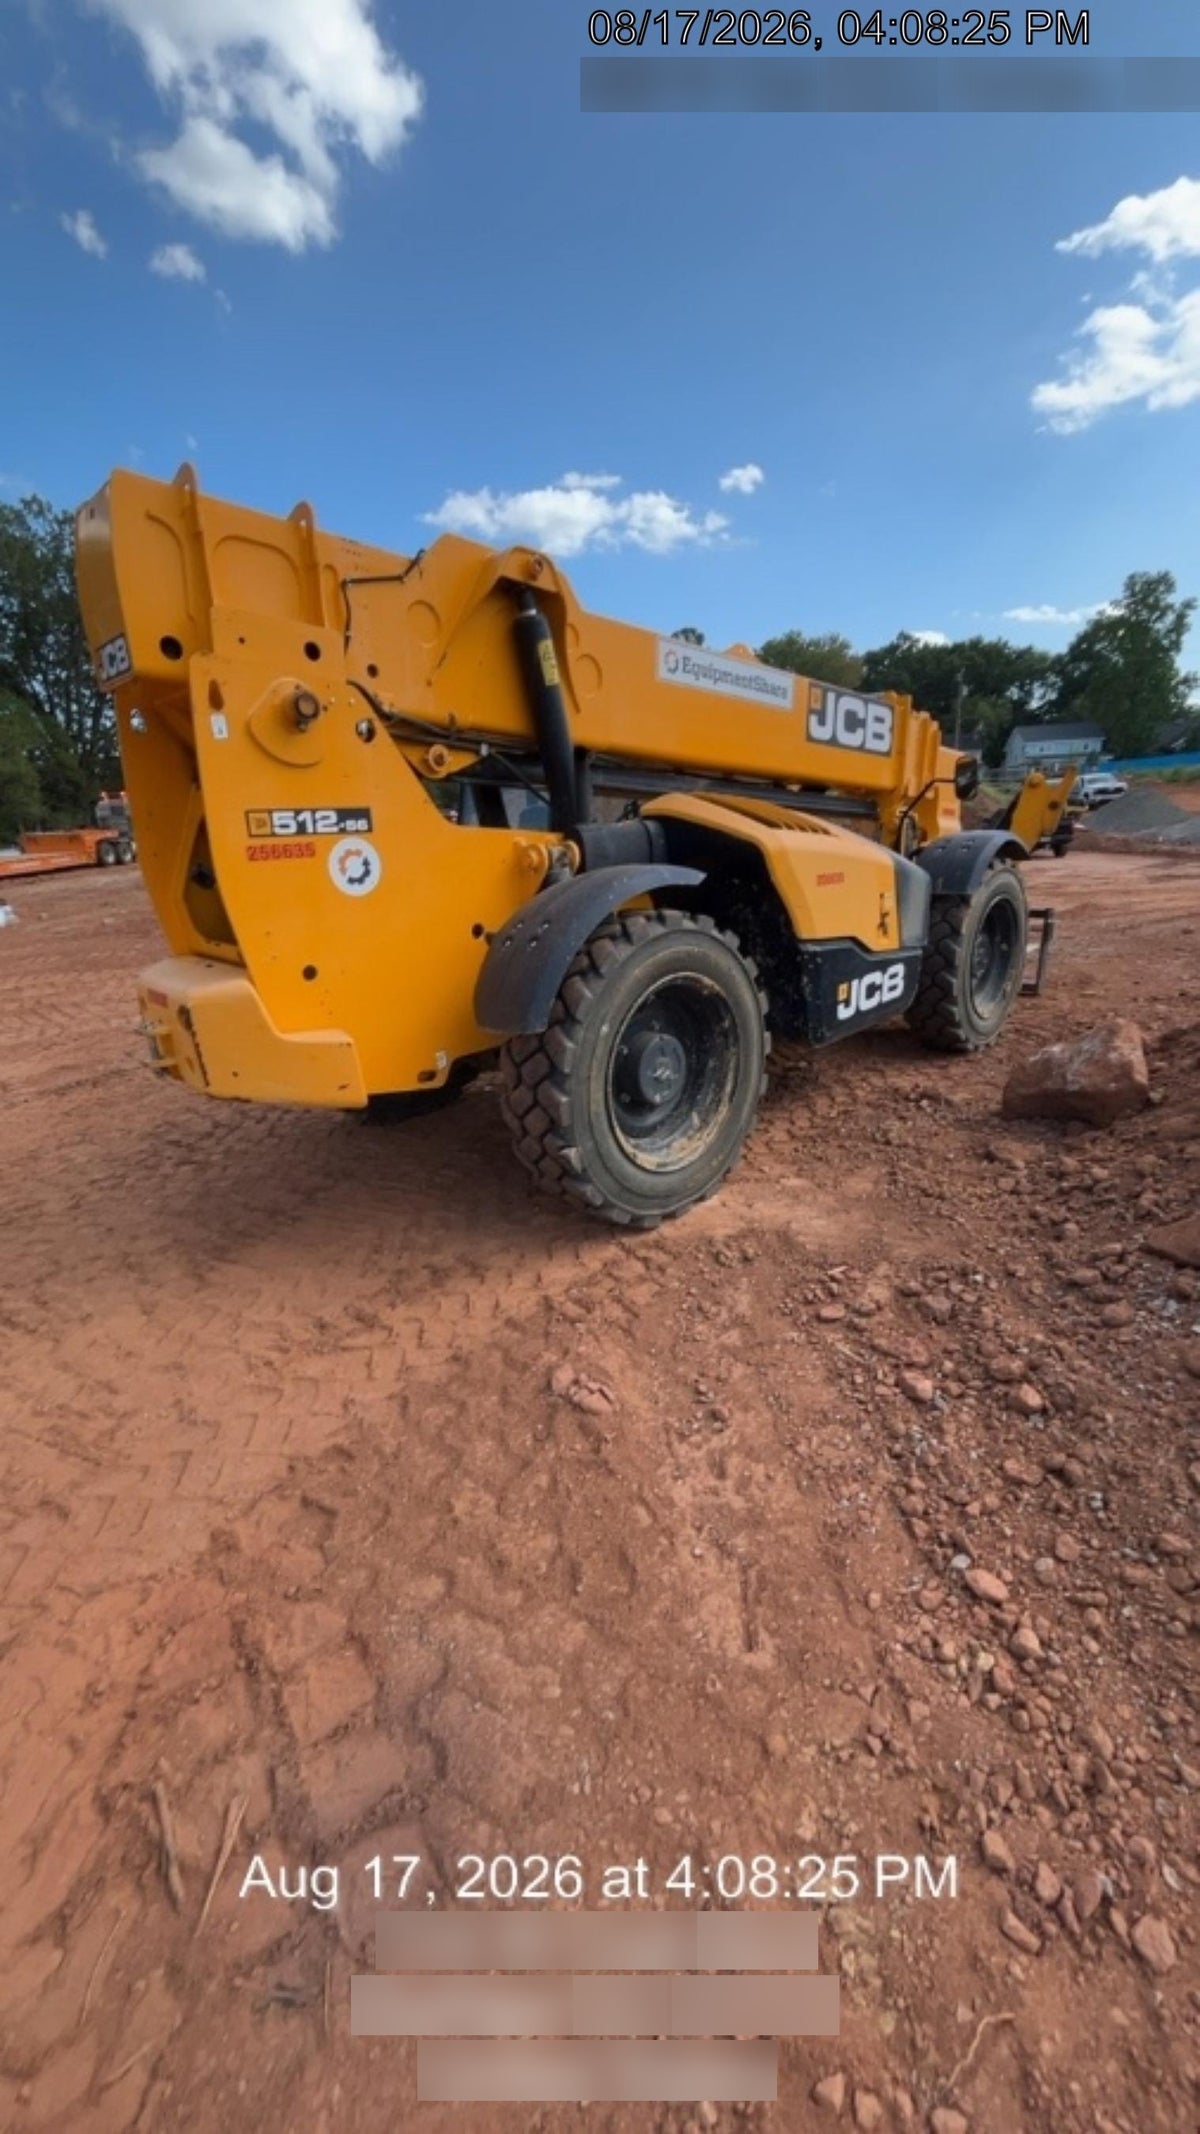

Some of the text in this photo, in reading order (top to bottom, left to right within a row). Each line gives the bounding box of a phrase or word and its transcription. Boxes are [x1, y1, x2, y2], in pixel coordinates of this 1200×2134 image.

[682, 656, 788, 701] EquipmentShare
[808, 691, 894, 754] JCB
[836, 962, 905, 1021] JCB
